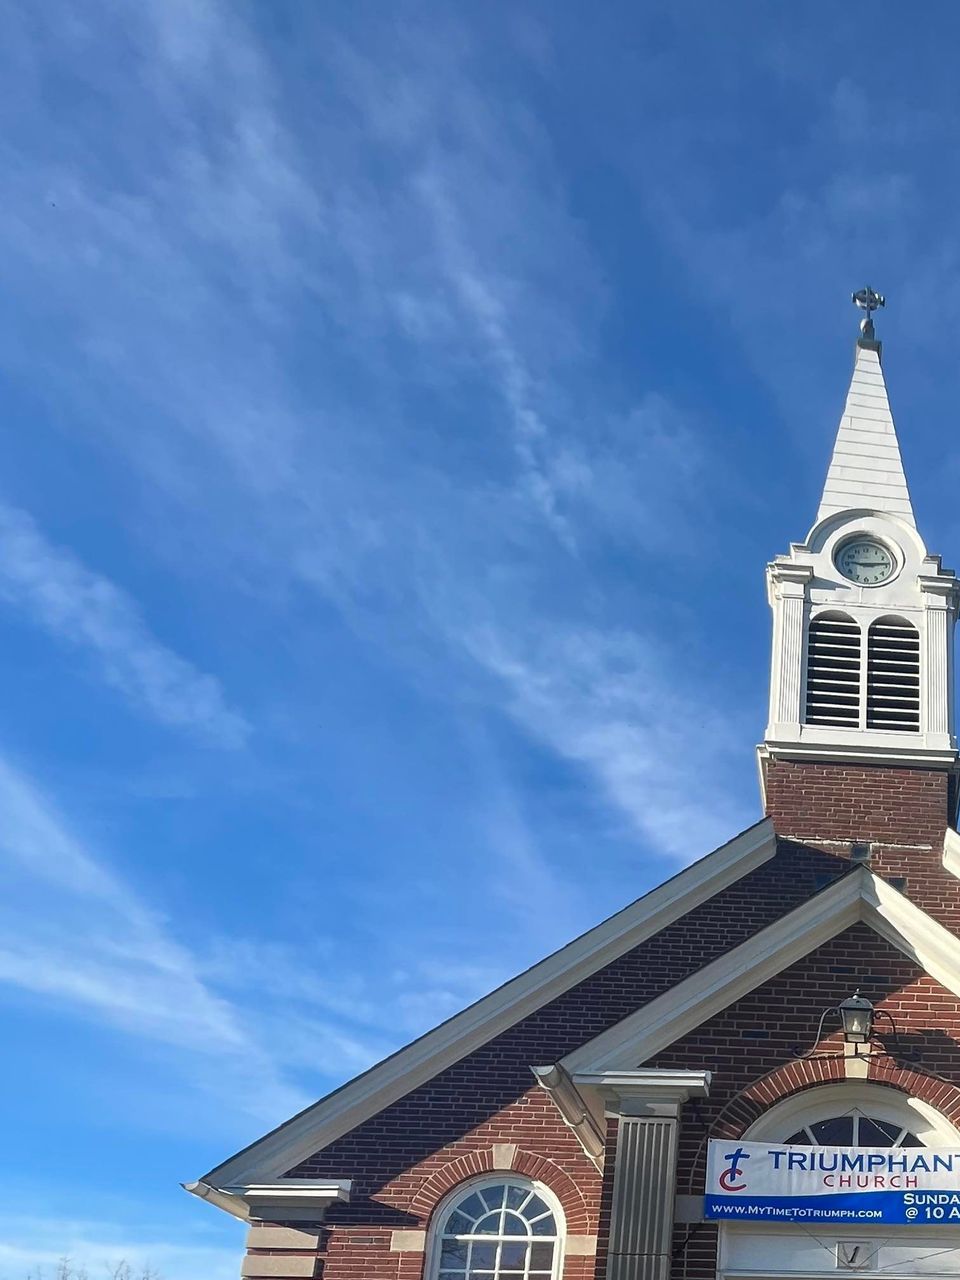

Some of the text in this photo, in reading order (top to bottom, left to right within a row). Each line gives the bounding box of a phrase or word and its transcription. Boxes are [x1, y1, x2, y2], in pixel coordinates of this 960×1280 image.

[823, 1175, 918, 1188] CHURCH
[905, 1207, 918, 1218] @
[925, 1207, 944, 1219] 10
